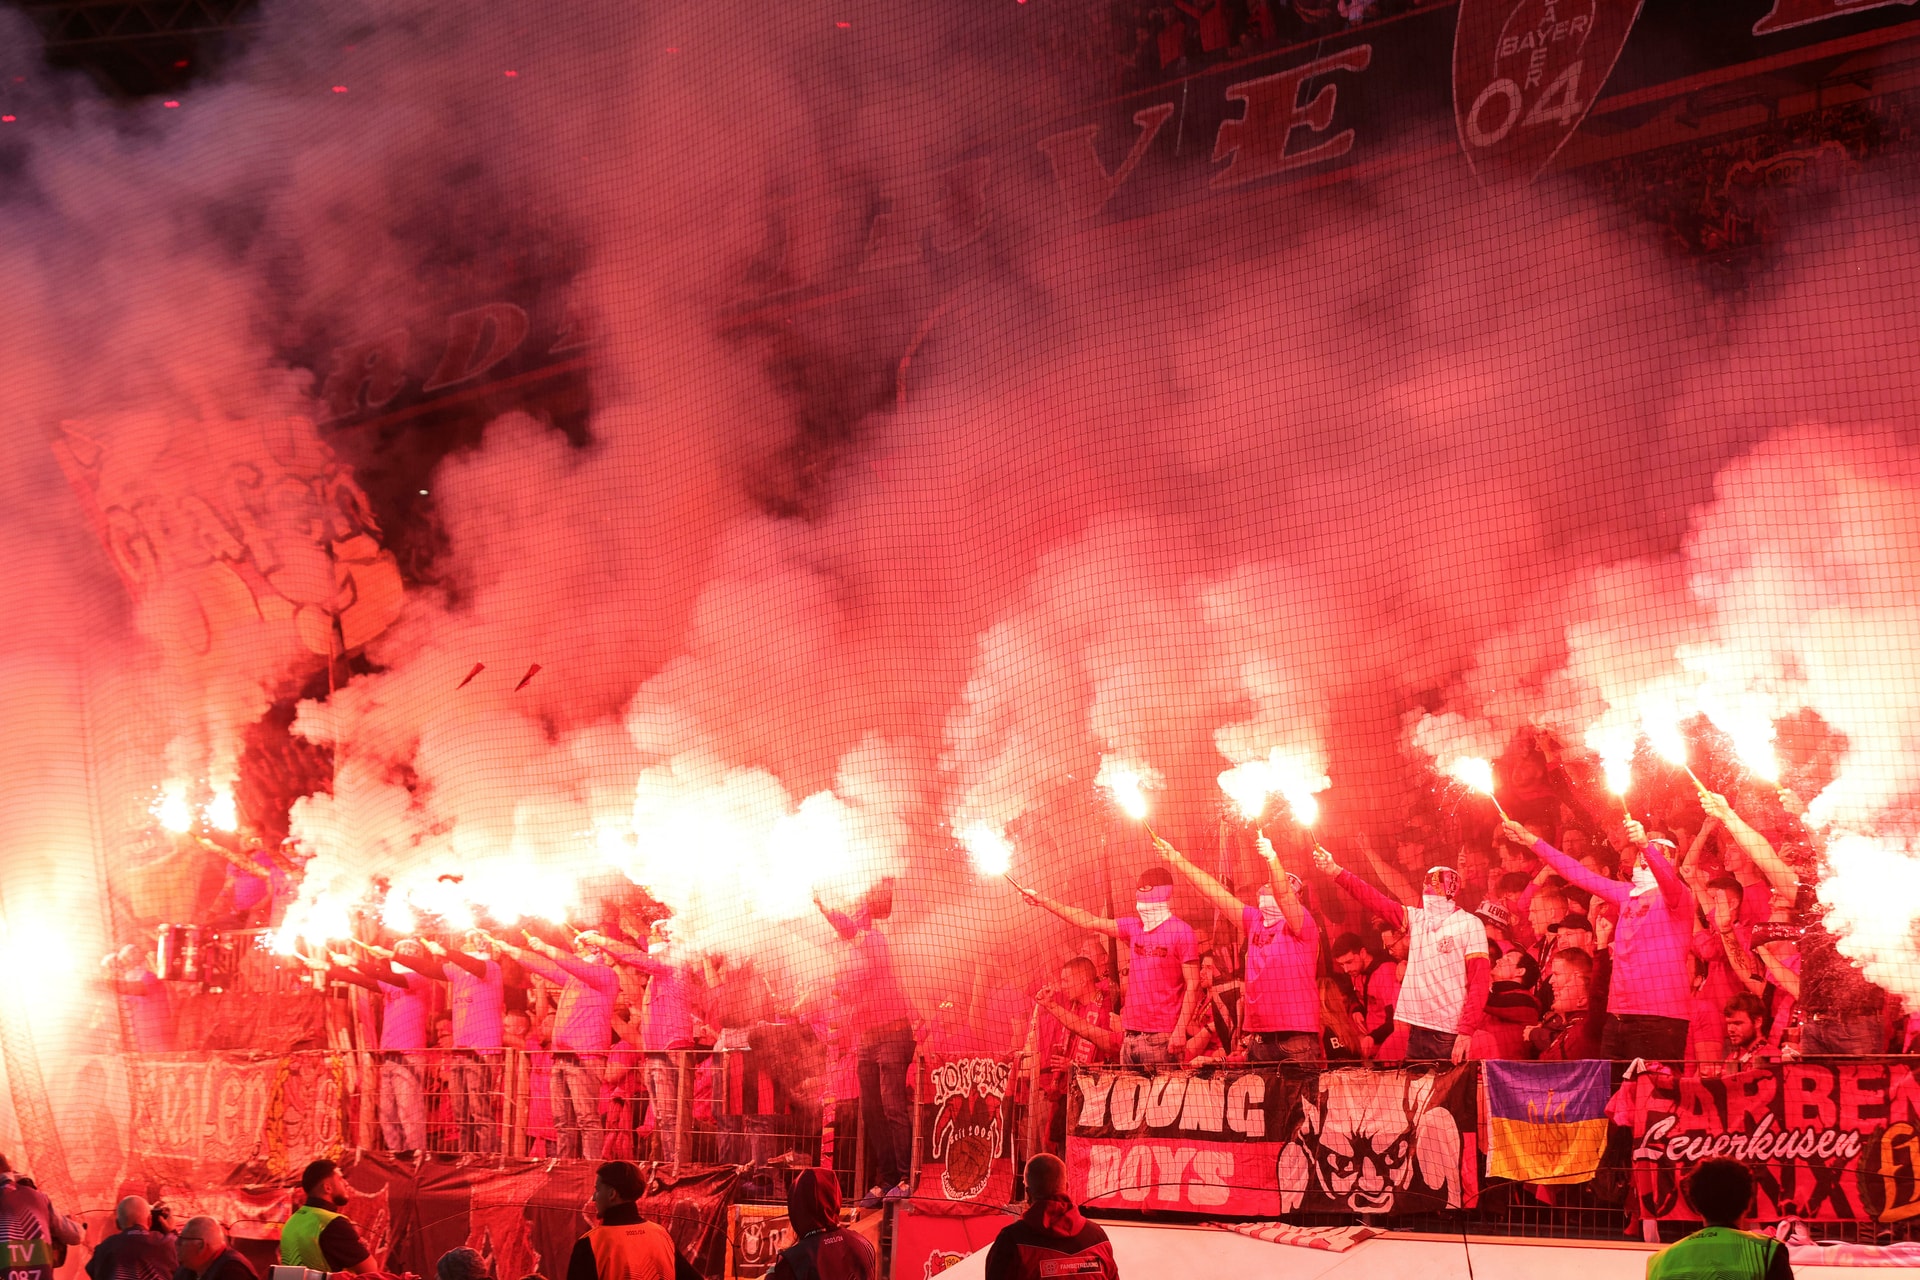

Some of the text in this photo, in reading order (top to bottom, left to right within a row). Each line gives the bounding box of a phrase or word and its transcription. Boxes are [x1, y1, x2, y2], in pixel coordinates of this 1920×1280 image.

[1500, 14, 1589, 57] BAYER
[1465, 60, 1583, 147] 04
[1077, 1074, 1266, 1137] YOUNG
[1632, 1112, 1862, 1161] Leverkusen
[1086, 1145, 1235, 1206] BOYS
[7, 1243, 35, 1262] TV
